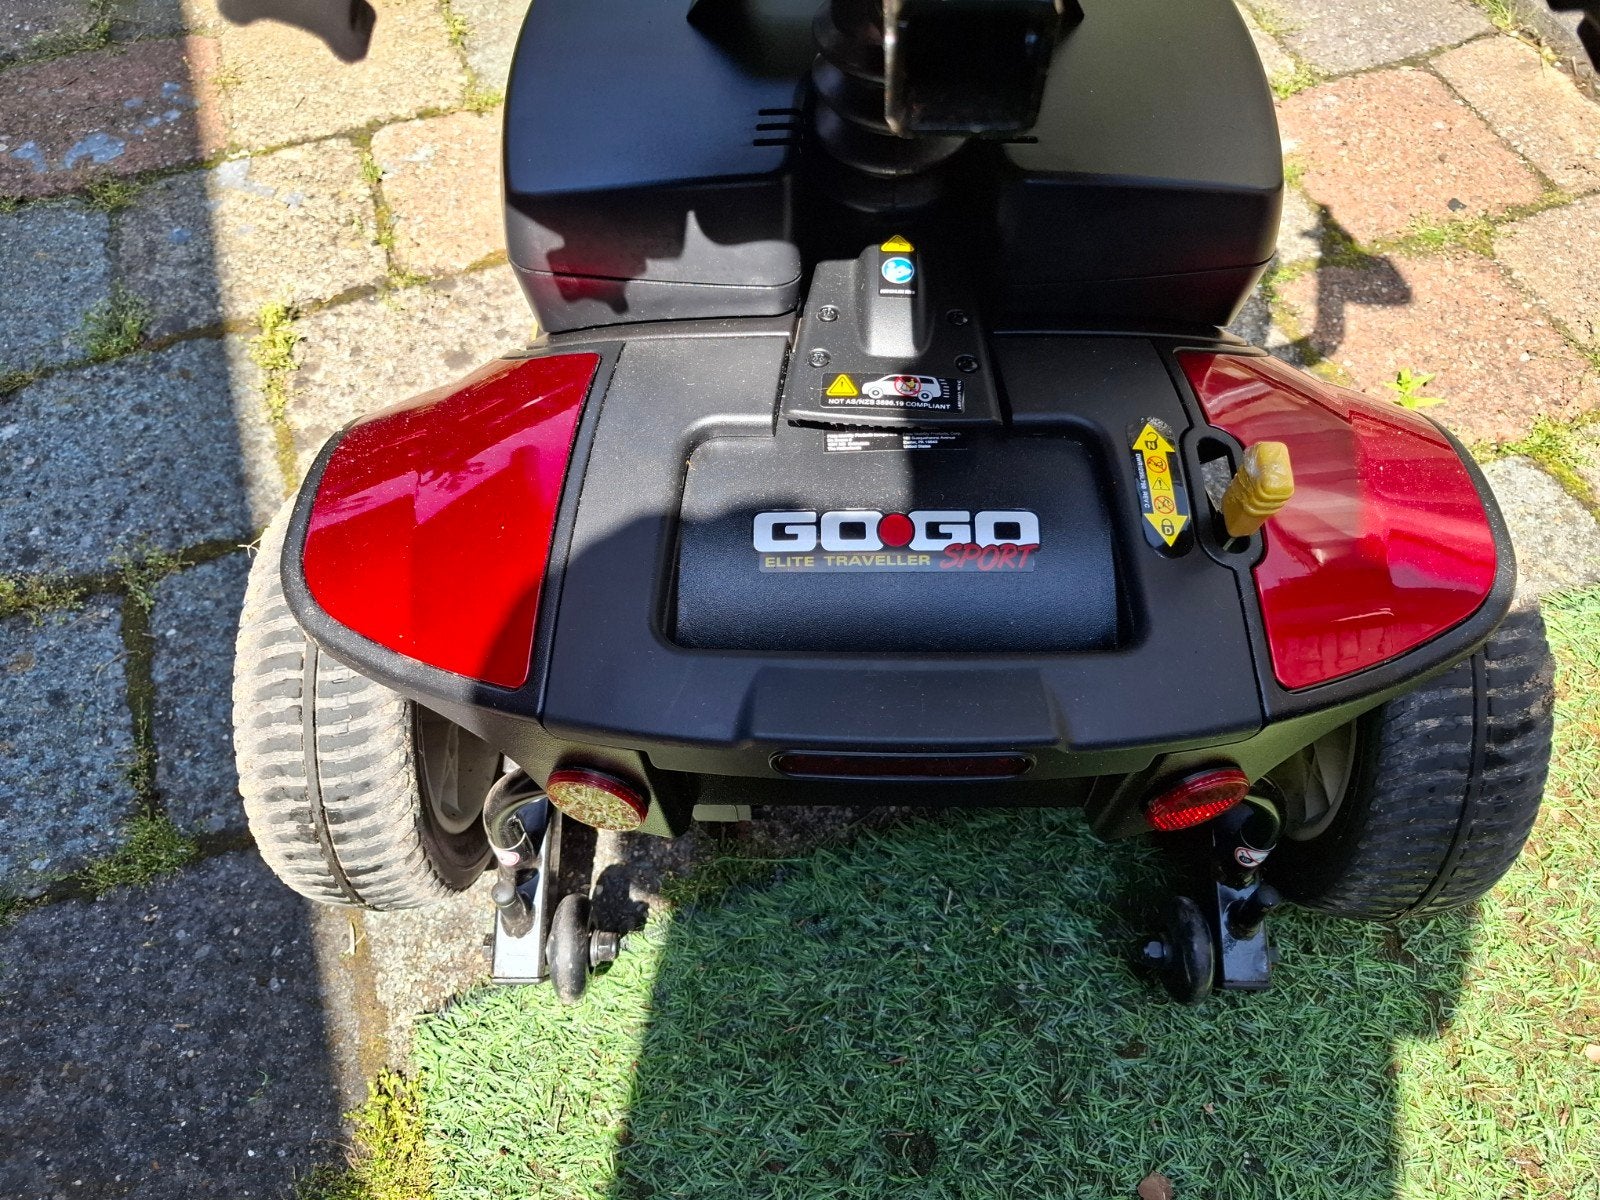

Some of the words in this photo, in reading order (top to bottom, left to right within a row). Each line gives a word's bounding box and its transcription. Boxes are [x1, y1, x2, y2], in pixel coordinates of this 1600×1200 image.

[905, 402, 951, 410] COMPLIANT
[765, 555, 815, 568] ELITE
[824, 554, 931, 567] TRAVELLER
[939, 542, 1040, 571] SPORT
